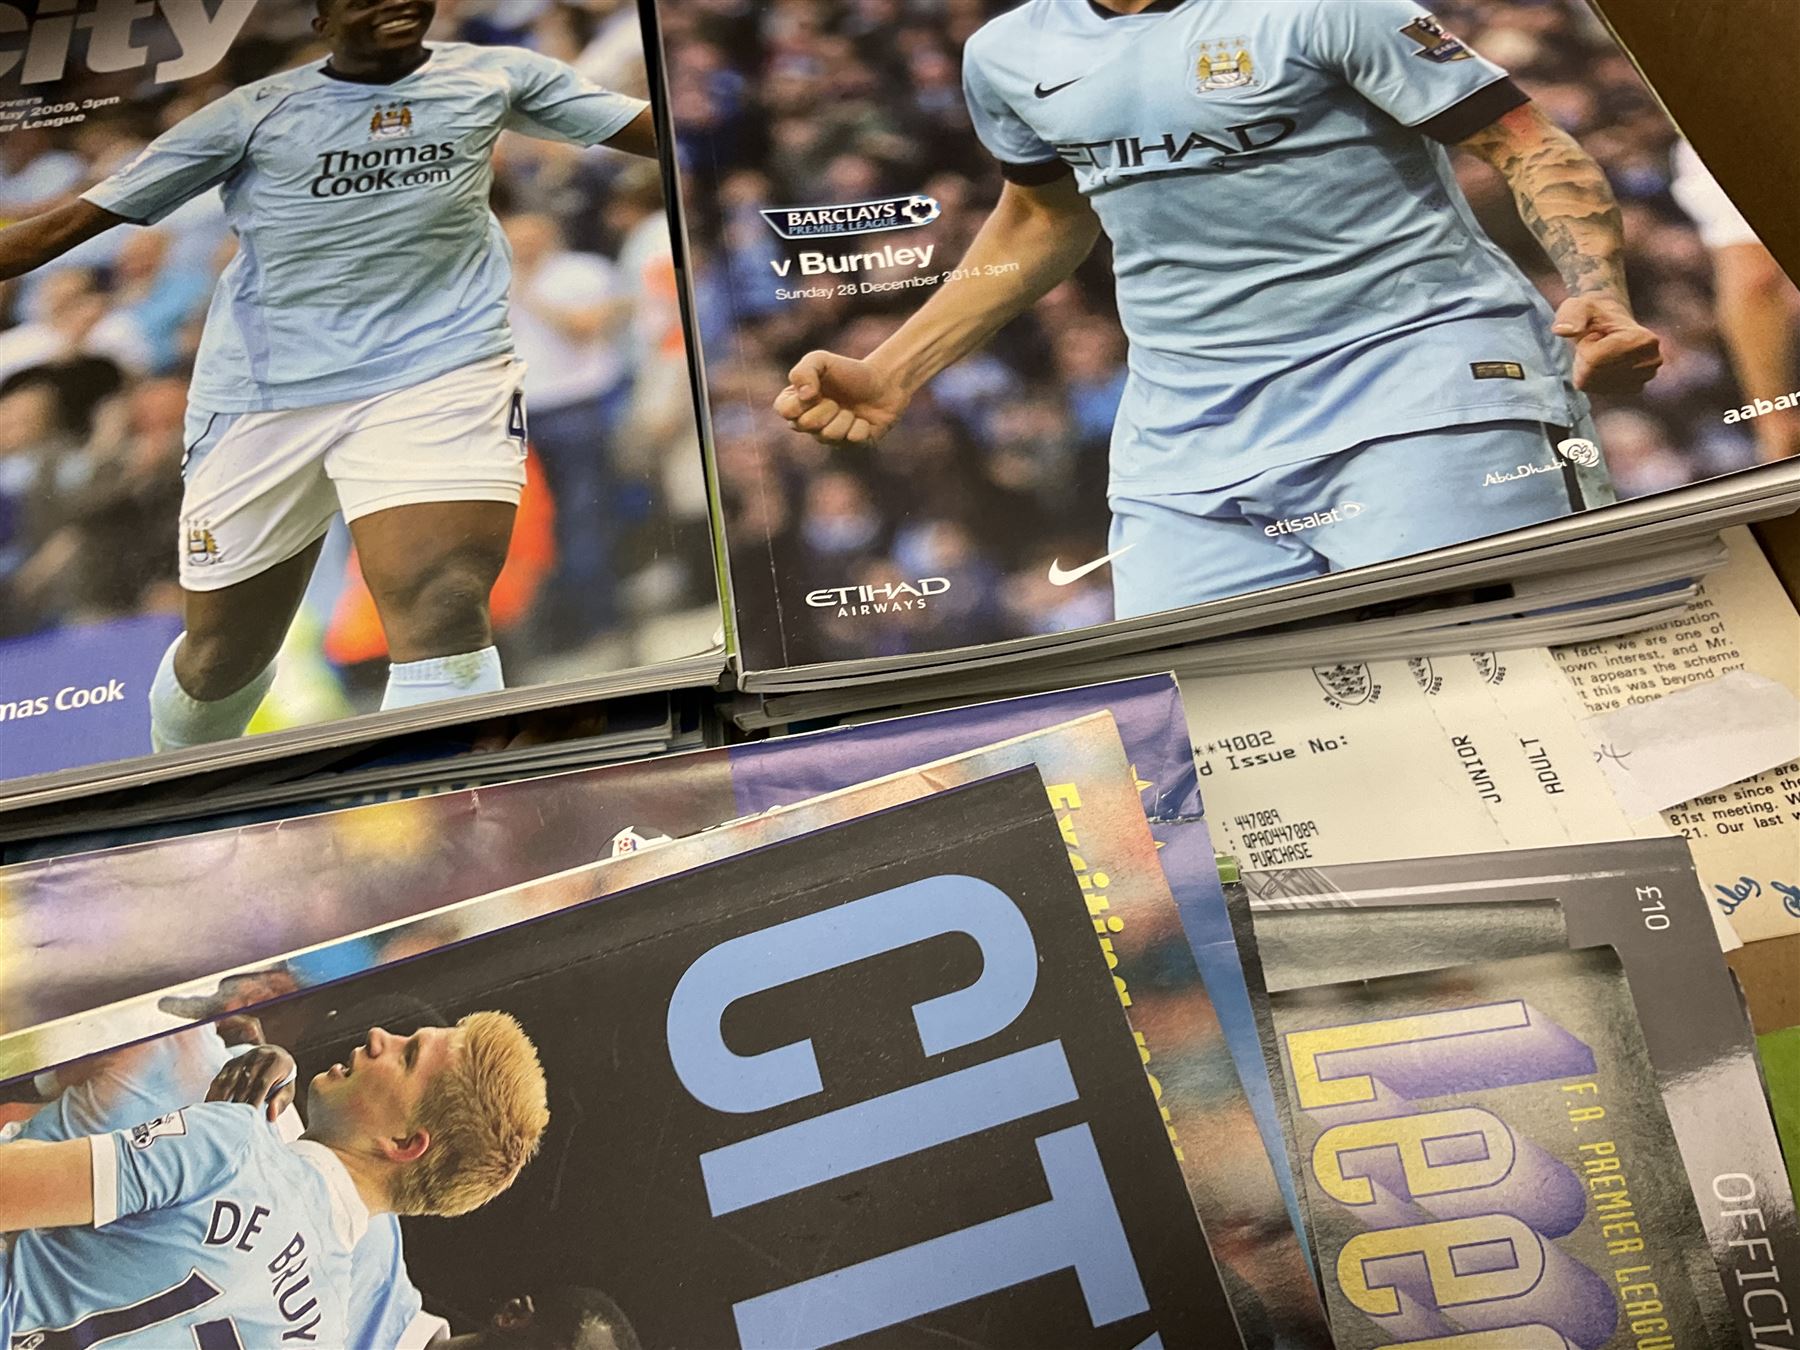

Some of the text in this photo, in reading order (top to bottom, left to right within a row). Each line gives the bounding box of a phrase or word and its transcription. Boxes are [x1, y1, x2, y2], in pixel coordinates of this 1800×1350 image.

[21, 114, 86, 130] League
[30, 102, 80, 117] 2009,
[82, 96, 120, 110] 3pm
[317, 141, 455, 176] Thomas
[787, 203, 896, 226] BARCLAYS
[789, 217, 898, 235] PREMIER LEAGUE
[770, 245, 935, 277] v Burnley
[775, 261, 1020, 301] Sunday 28 December 2014 3pm
[1264, 507, 1343, 538] etisalat
[805, 577, 951, 608] ETIHAD
[837, 598, 927, 618] AIRWAYS
[1615, 640, 1637, 651] we
[1645, 635, 1668, 647] are
[1675, 630, 1702, 641] one
[1710, 621, 1725, 635] of
[1672, 643, 1698, 656] and
[1705, 637, 1733, 650] Mr.
[1590, 667, 1647, 684] appears
[1653, 661, 1676, 674] the
[1684, 650, 1740, 668] scheme
[1593, 684, 1621, 697] this
[1626, 680, 1656, 692] was
[1661, 667, 1715, 686] beyond
[55, 679, 126, 711] Cook
[1226, 748, 1297, 771] Issue
[1308, 735, 1349, 754] No:
[1519, 737, 1565, 795] ADULT
[1451, 735, 1502, 804] JUNIOR
[1733, 785, 1775, 801] since
[1670, 811, 1706, 826] 81st
[1712, 801, 1779, 819] meeting.
[1716, 821, 1745, 835] Our
[1753, 814, 1785, 829] last
[1250, 842, 1313, 869] PURCHASE
[1635, 885, 1670, 931] £10
[666, 873, 1166, 1350] CIT
[1562, 1081, 1606, 1133] F.A.
[1284, 998, 1572, 1350] Lee
[1578, 1140, 1645, 1256] PREMIER
[204, 1200, 270, 1252] DE
[1712, 1172, 1800, 1350] OFFICI
